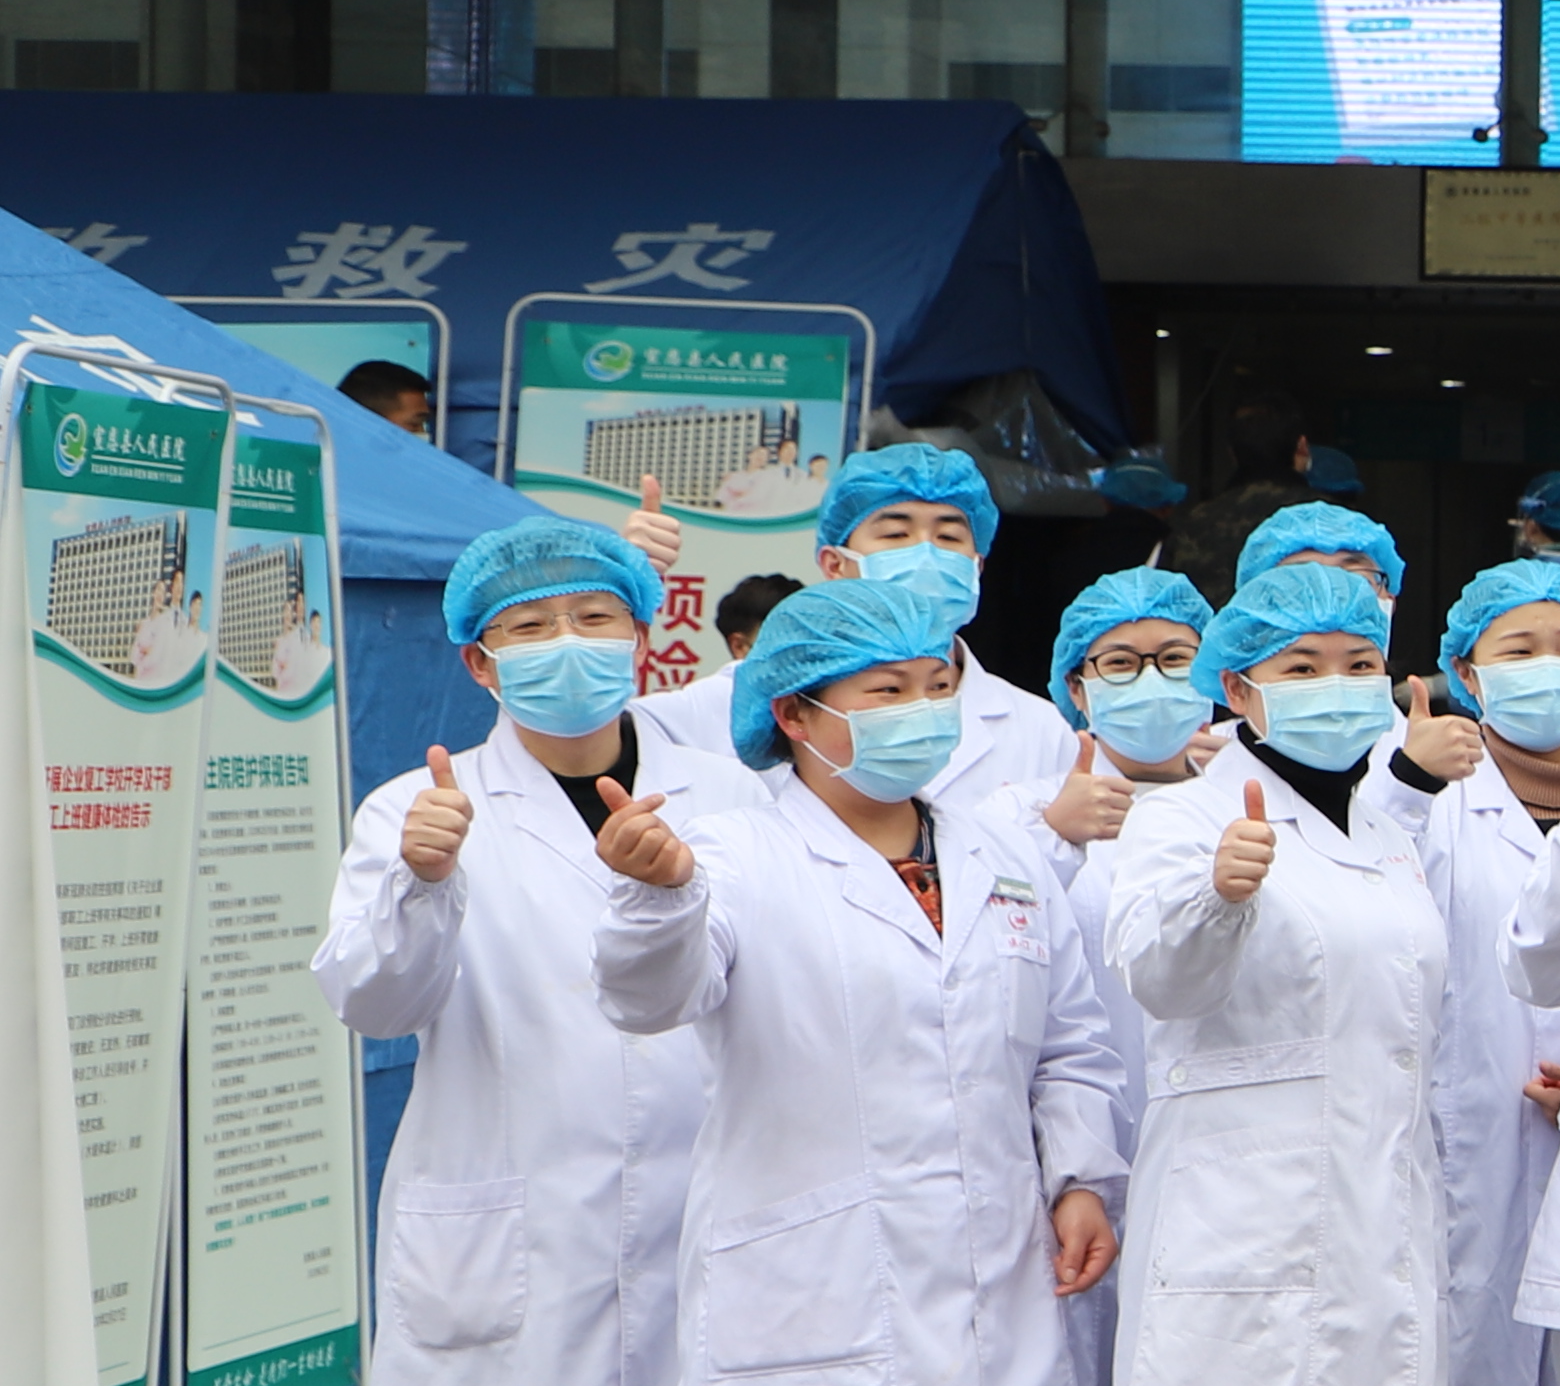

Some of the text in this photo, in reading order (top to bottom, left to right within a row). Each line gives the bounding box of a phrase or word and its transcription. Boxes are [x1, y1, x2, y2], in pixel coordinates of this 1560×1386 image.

[644, 347, 788, 371] 宣恩县人民医院
[93, 424, 186, 461] 宣恩县人民医院
